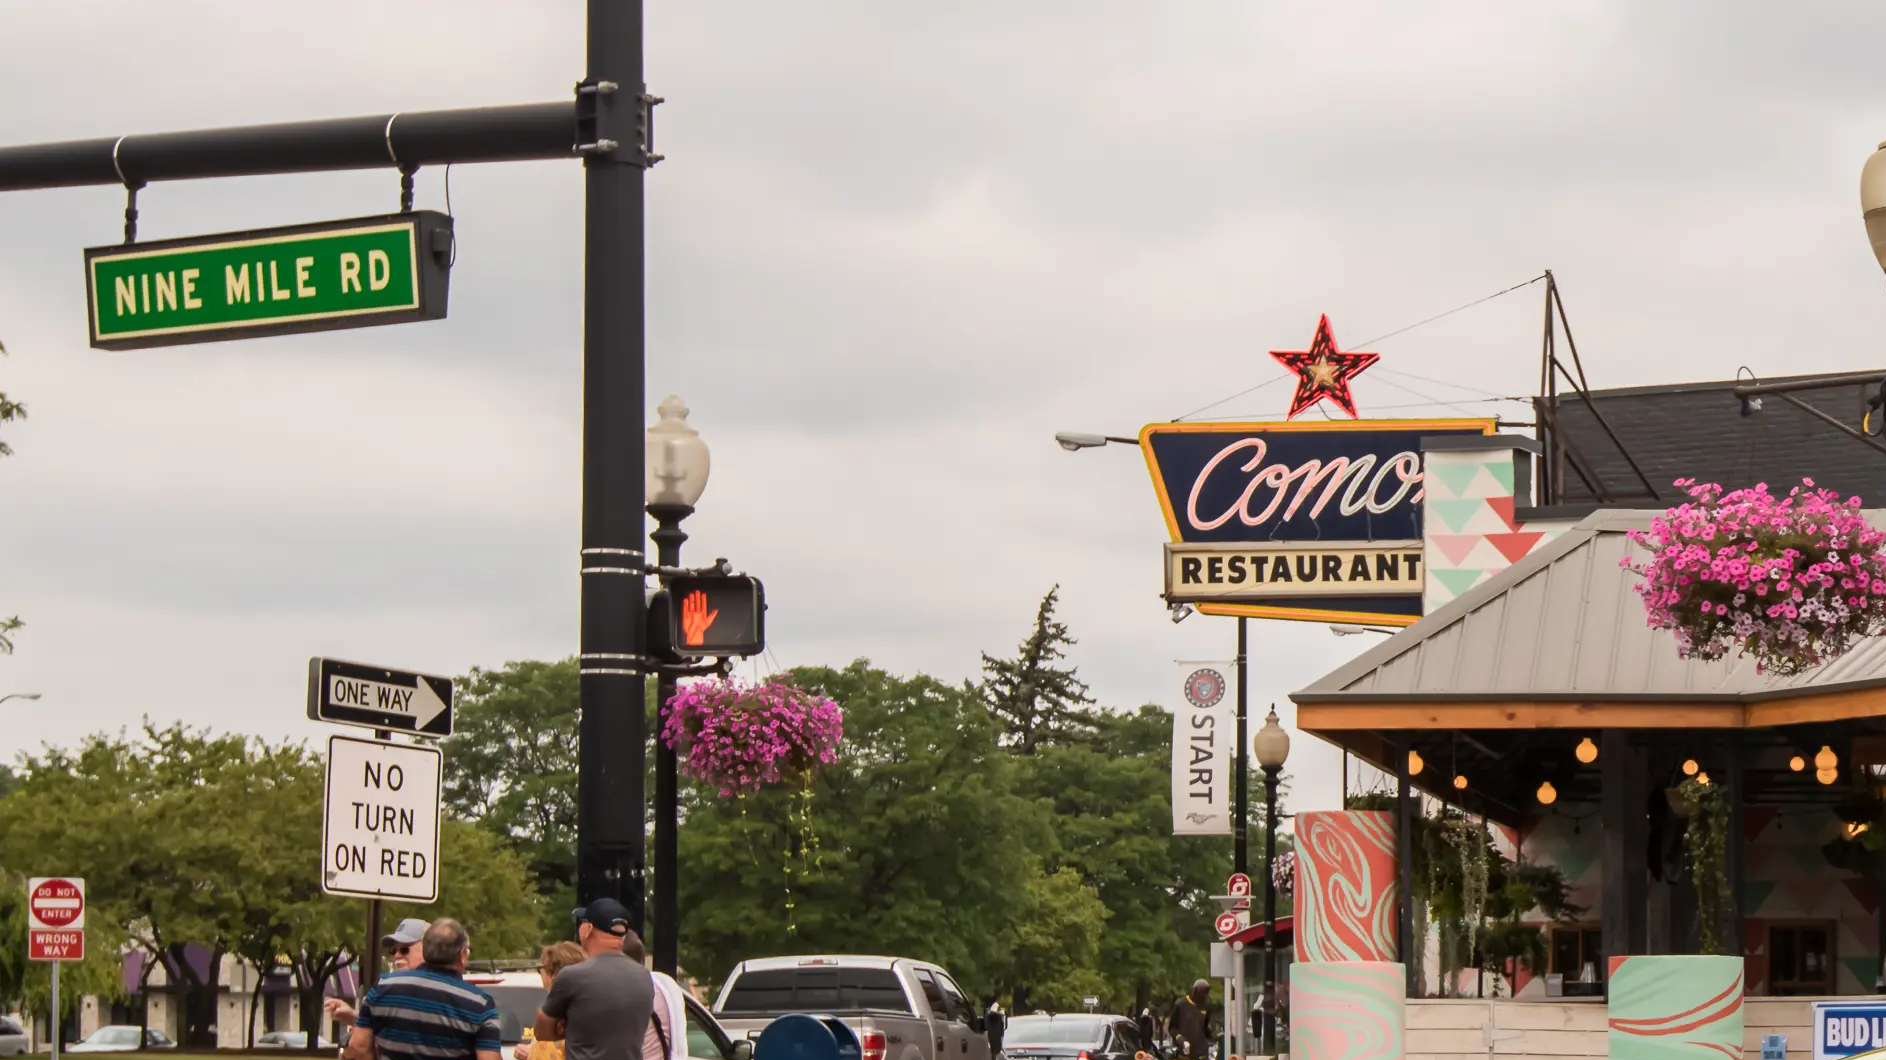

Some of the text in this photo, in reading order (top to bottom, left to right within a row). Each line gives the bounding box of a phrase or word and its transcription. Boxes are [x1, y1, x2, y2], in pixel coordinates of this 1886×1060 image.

[115, 249, 390, 317] NINE MILE RD
[1187, 437, 1425, 530] Como
[1181, 553, 1421, 584] RESTAURANT
[335, 679, 413, 712] ONE WAY
[1189, 714, 1215, 805] START
[364, 761, 404, 792] NO
[352, 801, 414, 836] TURN
[335, 843, 426, 879] ON RED
[38, 888, 75, 897] DO NOT
[41, 909, 72, 918] ENTER
[36, 933, 77, 944] WRONG
[44, 945, 68, 956] WAY
[1826, 1017, 1870, 1047] BUD
